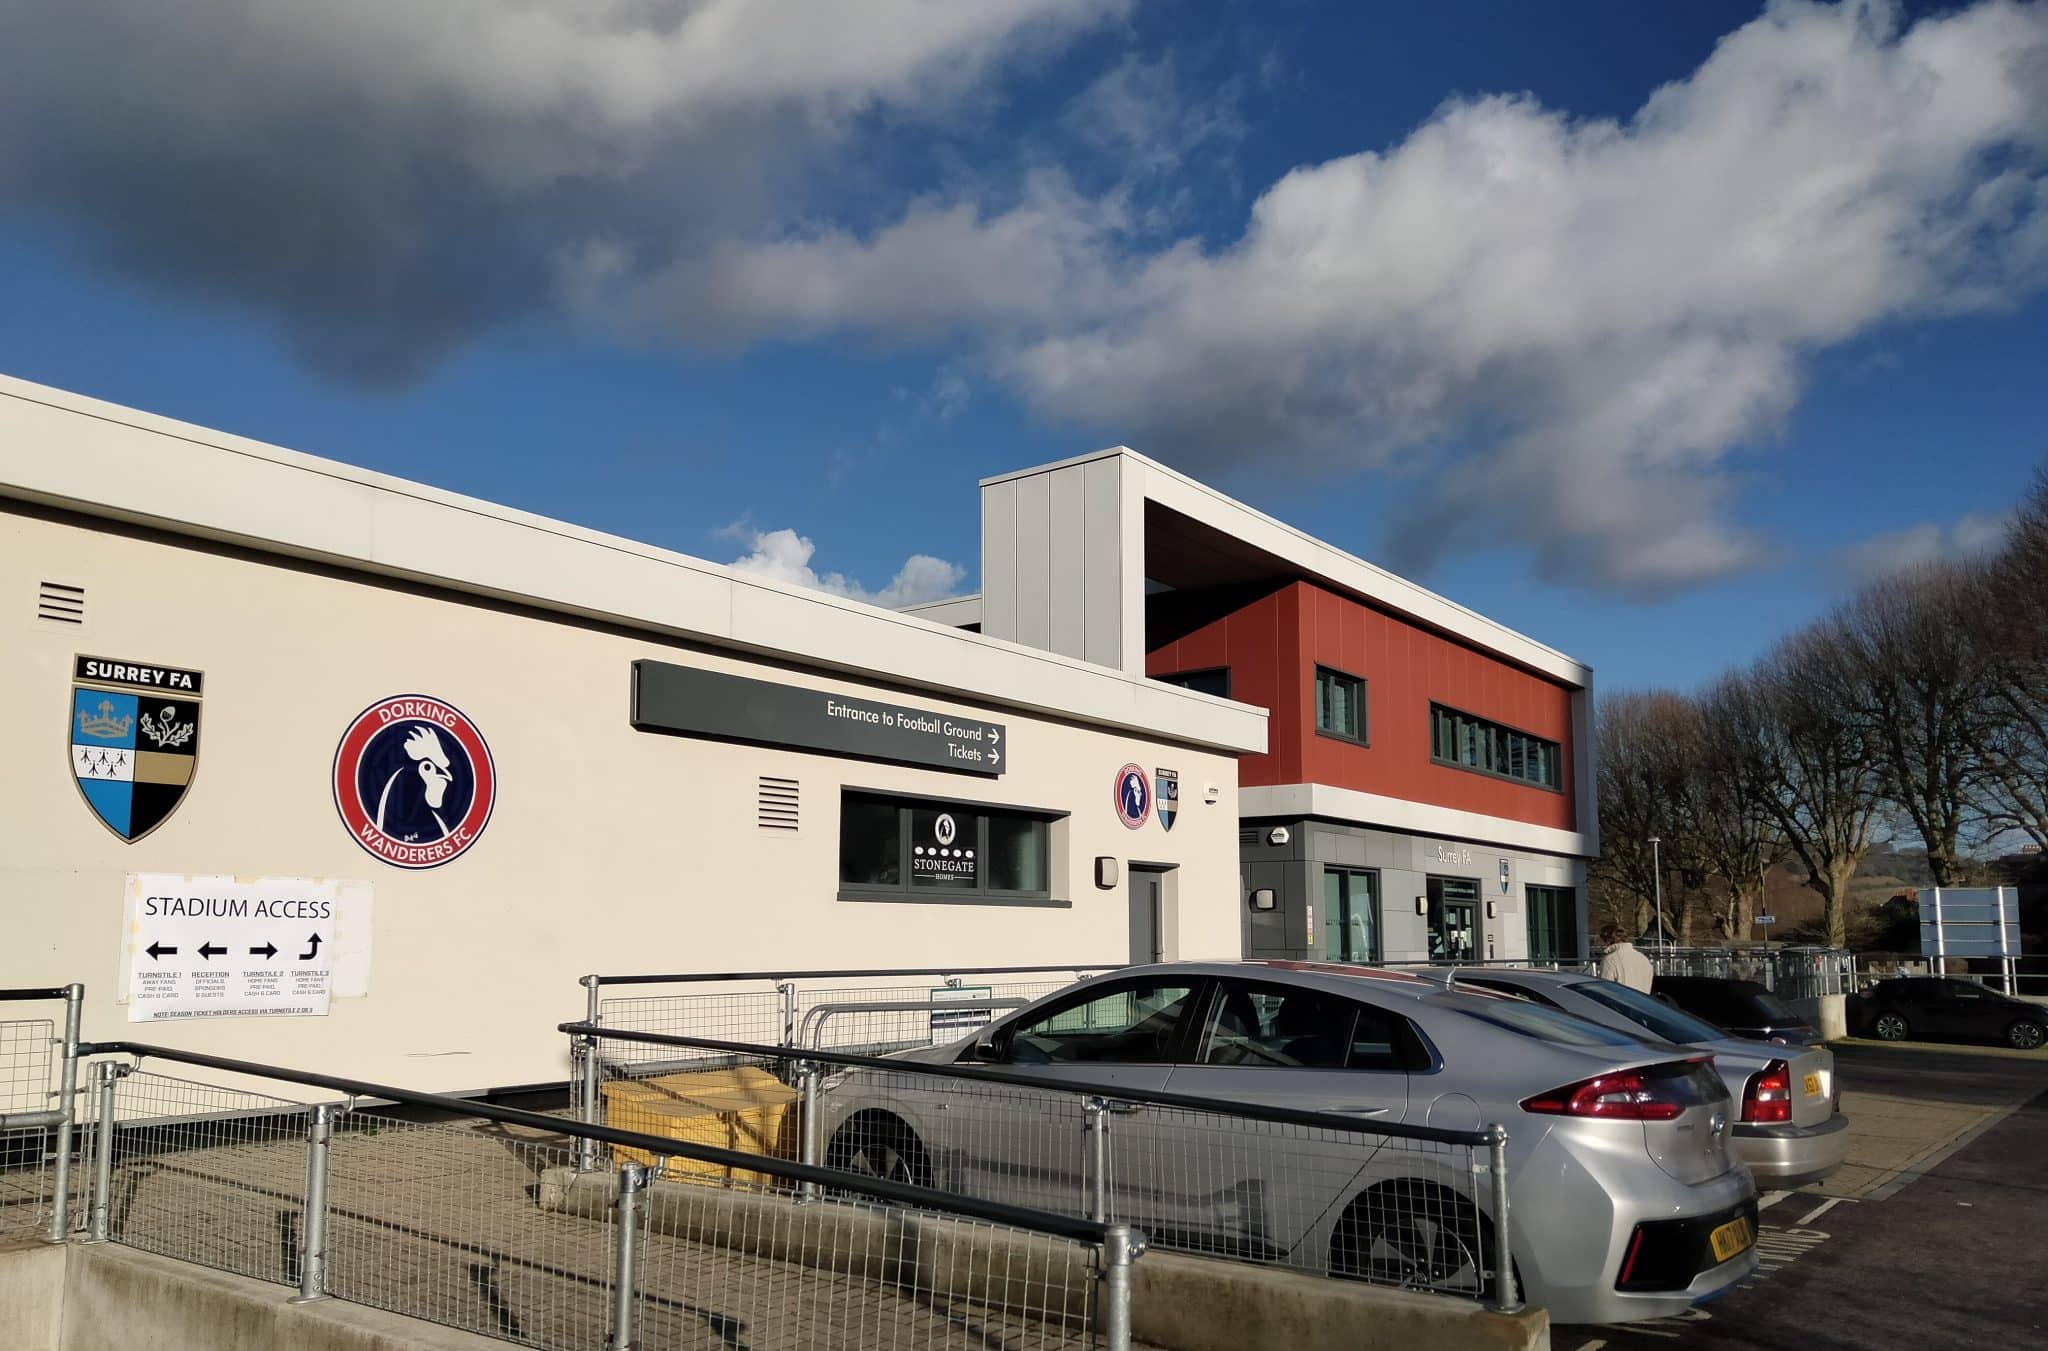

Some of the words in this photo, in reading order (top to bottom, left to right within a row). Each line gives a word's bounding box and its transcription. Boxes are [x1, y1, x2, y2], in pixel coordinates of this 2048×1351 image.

[86, 661, 165, 685] SURREY
[169, 672, 193, 689] FA
[378, 702, 457, 728] DORKING
[827, 700, 879, 723] Entrance
[882, 712, 894, 726] to
[897, 713, 941, 734] Football
[943, 722, 982, 741] Ground
[948, 743, 982, 761] Tickets
[360, 823, 453, 862] WANDERERS
[453, 827, 472, 847] FC
[914, 858, 975, 873] STONEGATE
[1438, 845, 1460, 868] Surrey
[1462, 849, 1472, 865] FA
[935, 873, 954, 881] HOMES
[144, 896, 248, 918] STADIUM
[254, 900, 331, 919] ACCESS
[191, 971, 230, 979] RECEPTION
